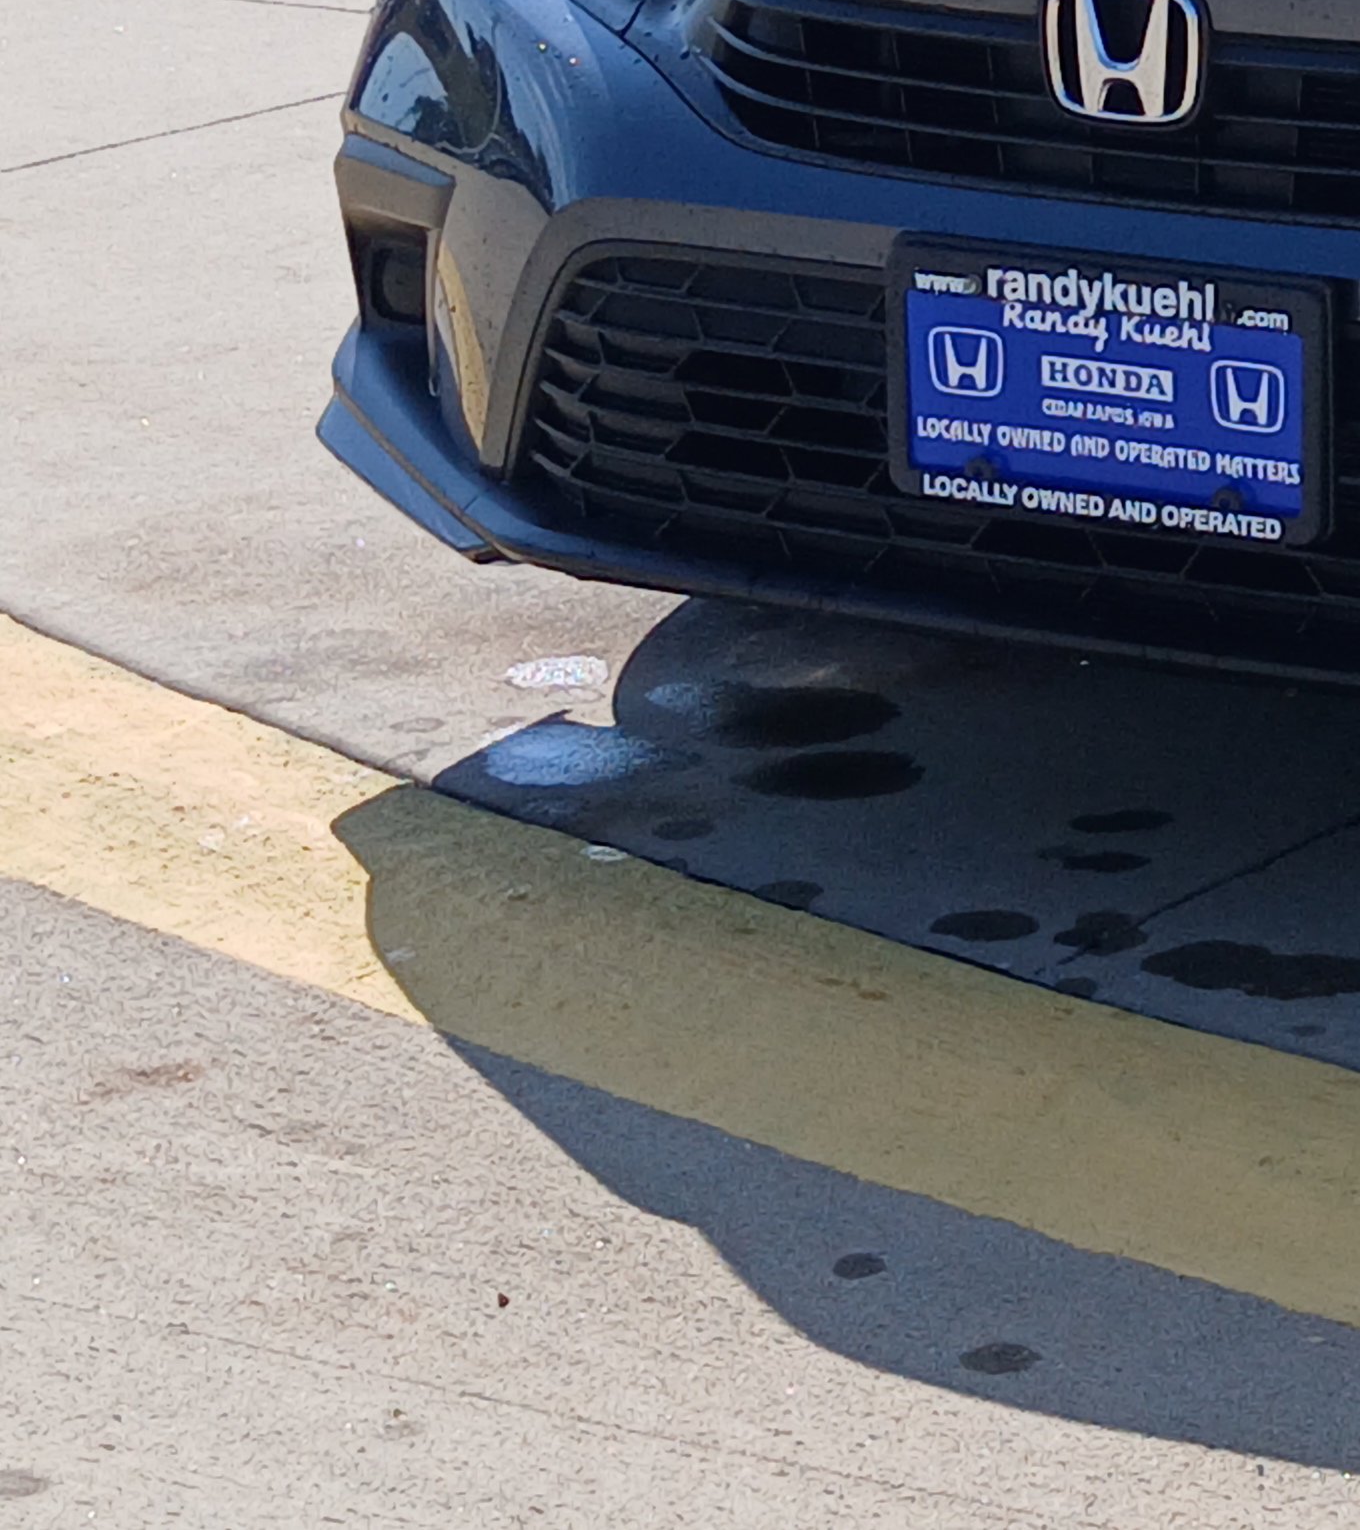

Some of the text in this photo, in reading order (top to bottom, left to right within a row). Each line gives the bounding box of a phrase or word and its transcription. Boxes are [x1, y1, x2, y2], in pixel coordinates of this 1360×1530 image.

[986, 267, 1215, 322] randykuehl
[1237, 309, 1289, 331] .com
[1003, 301, 1212, 353] Randy Kuehl
[1047, 360, 1168, 397] HONDA
[916, 415, 1301, 485] LOCALLY OWNED AND OPERATED MATTERS
[923, 473, 1282, 541] LOCALLY OWNED AND OPERATED
